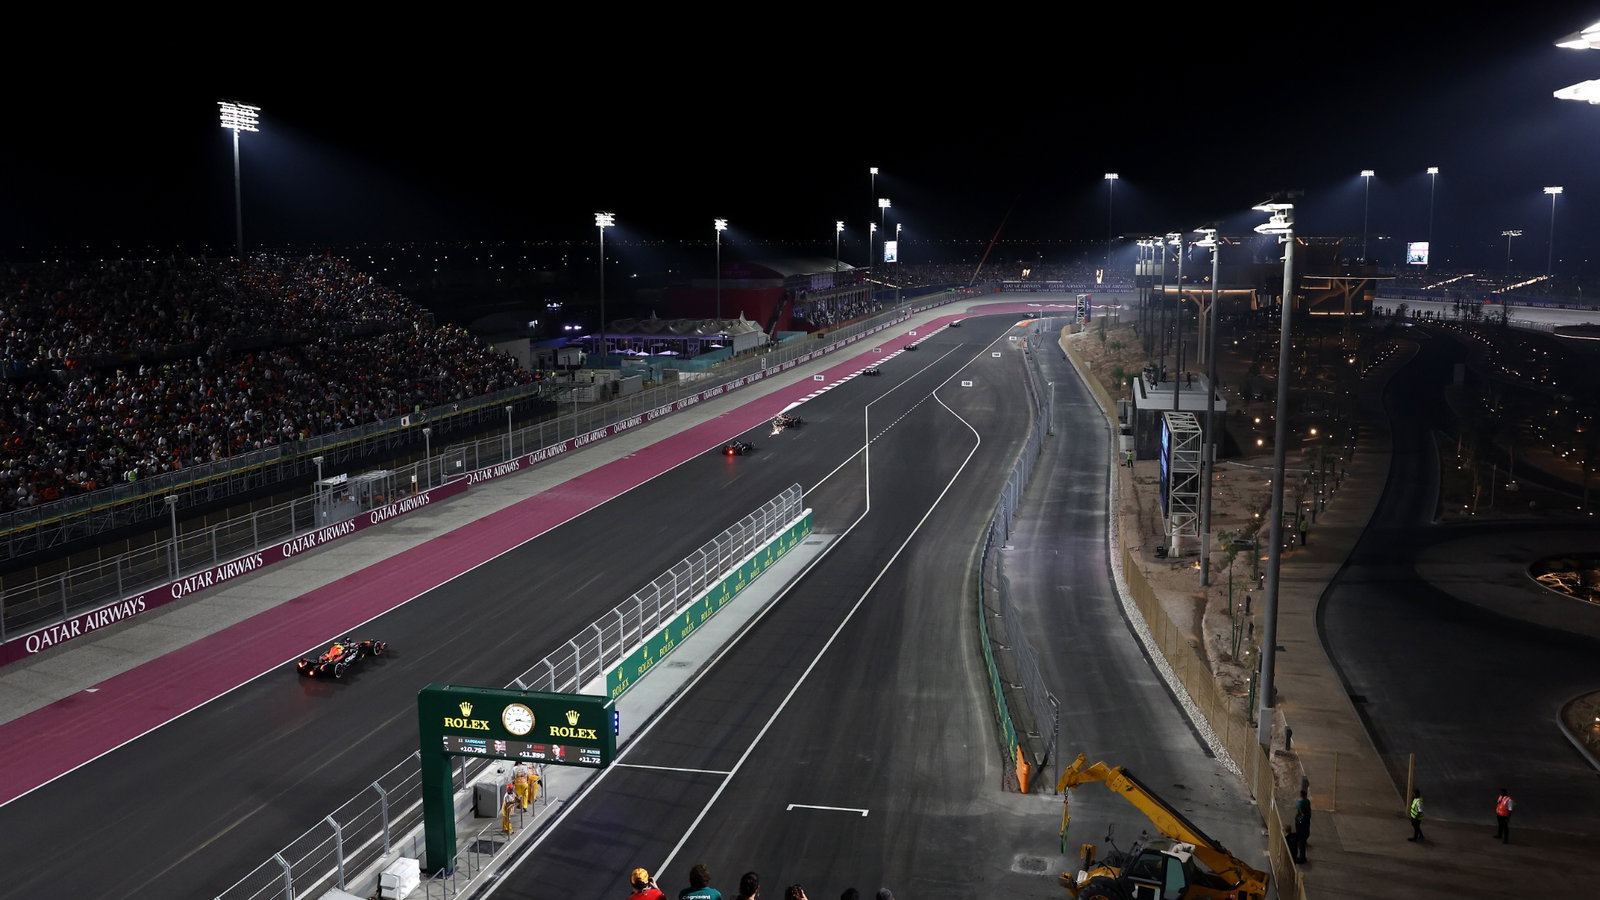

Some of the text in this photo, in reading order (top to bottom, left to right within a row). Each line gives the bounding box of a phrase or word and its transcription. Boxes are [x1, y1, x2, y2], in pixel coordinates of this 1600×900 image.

[574, 428, 608, 448] QATAR AIRWAYS
[529, 442, 567, 465] QATAR AIRWAYS
[465, 460, 520, 485] QATAR AIRWAYS
[370, 492, 430, 525] QATAR AIRWAYS
[282, 518, 356, 558] QATAR AIRWAYS
[171, 552, 264, 599] QATAR AIRWAYS
[701, 606, 713, 622] ROLEX
[25, 596, 146, 654] QATAR AIRWAYS
[682, 621, 694, 638] ROLEX
[660, 638, 674, 658] ROLEX
[638, 656, 654, 676] ROLEX
[612, 677, 630, 698] ROLEX
[444, 717, 490, 731] ROLEX
[550, 726, 598, 740] ROLEX
[460, 746, 487, 754] +10.796
[519, 751, 546, 759] +11.399
